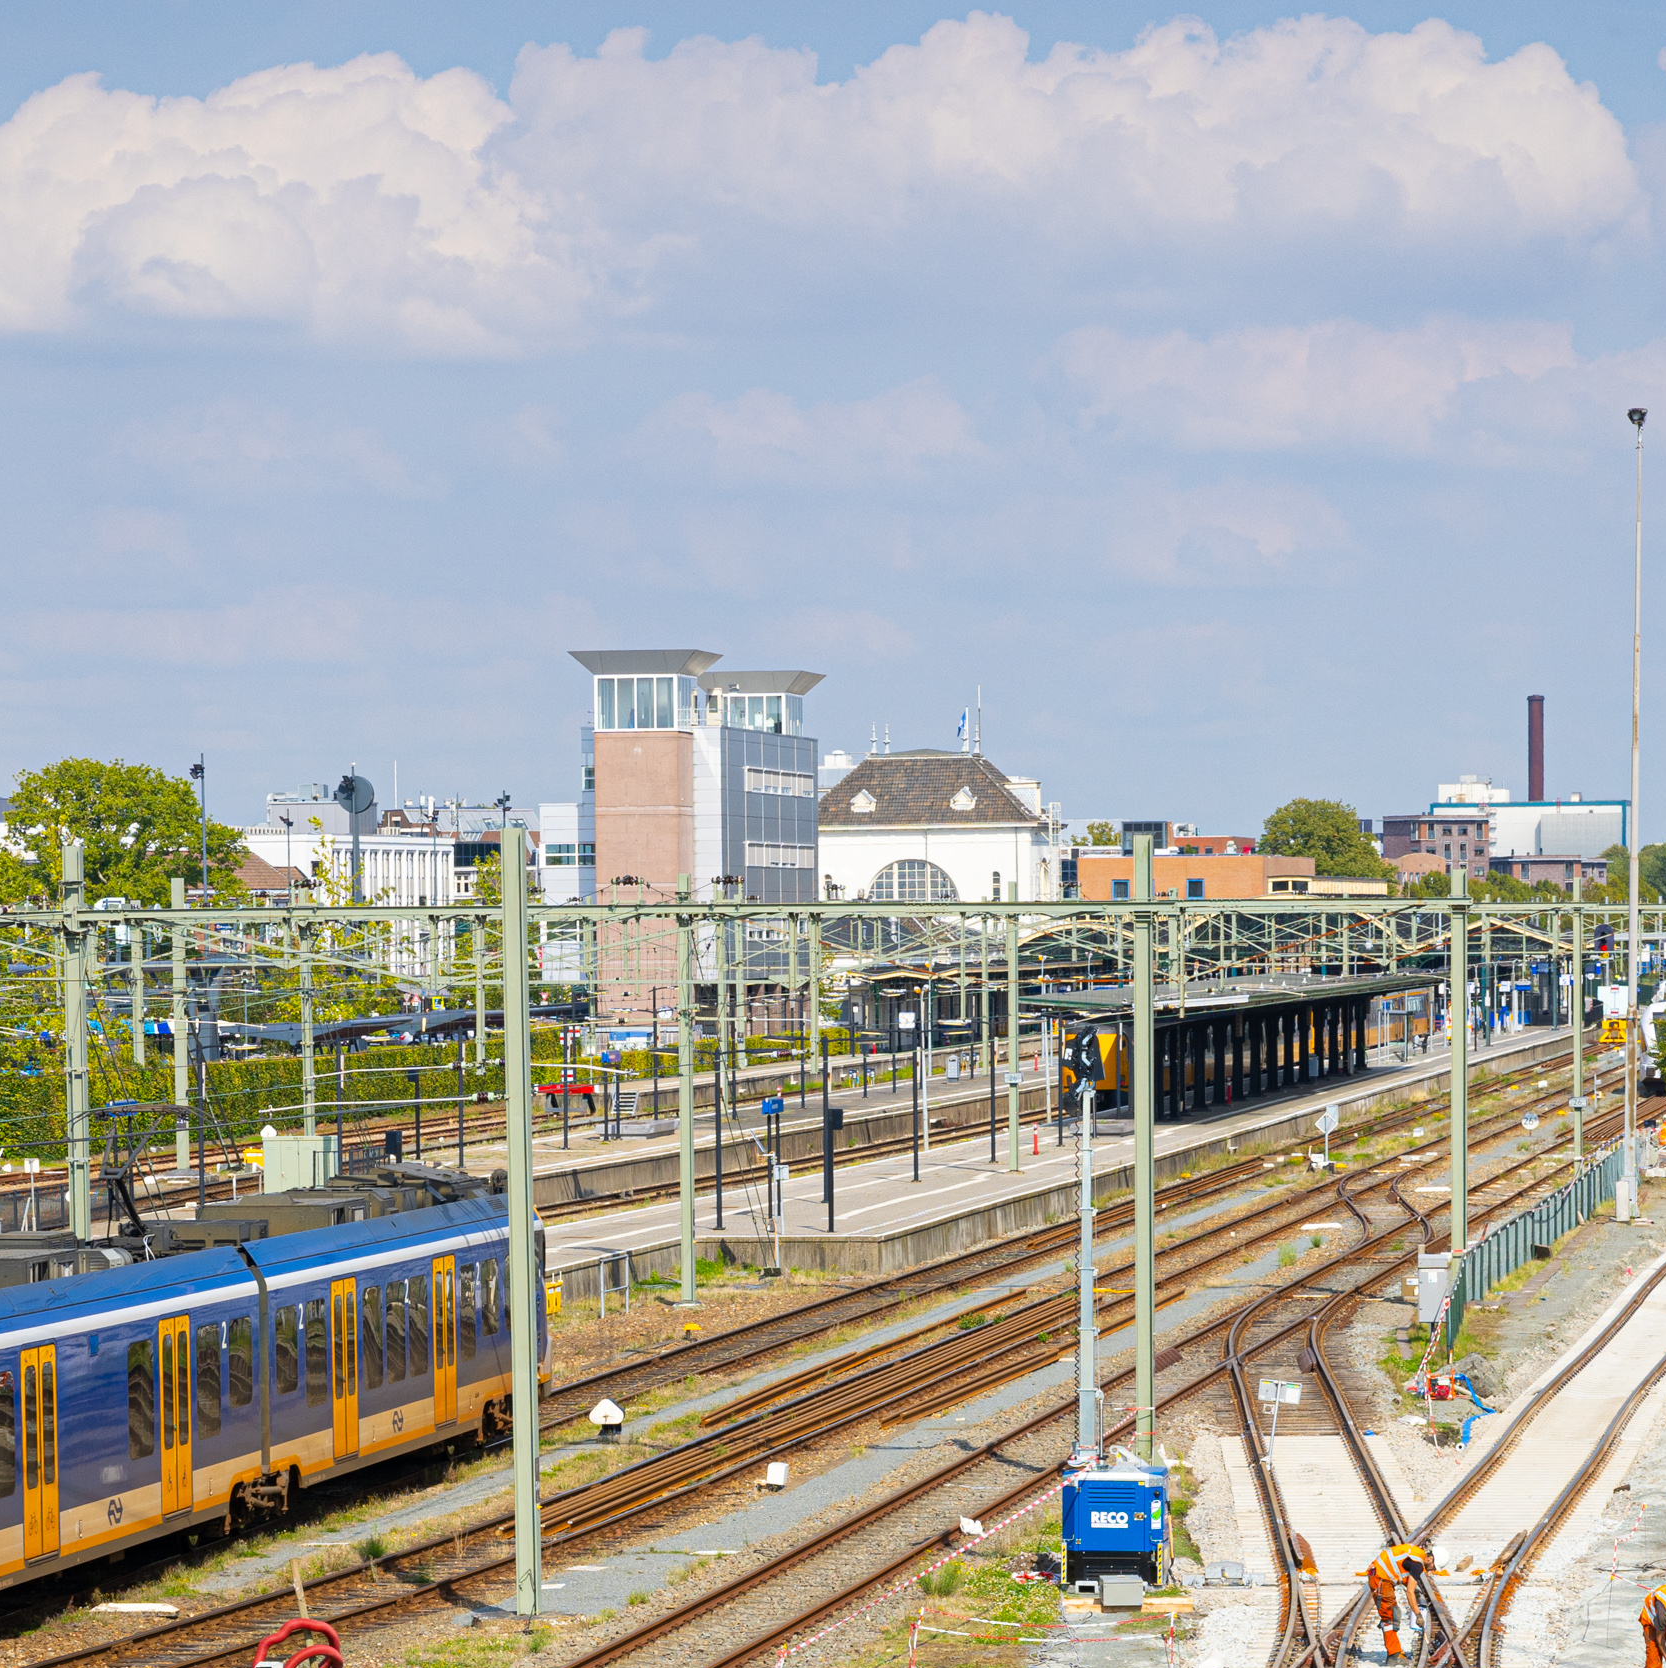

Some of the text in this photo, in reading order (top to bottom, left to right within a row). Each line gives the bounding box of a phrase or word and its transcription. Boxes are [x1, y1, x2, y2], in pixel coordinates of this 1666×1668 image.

[475, 1261, 480, 1286] 2
[404, 1278, 409, 1304] 2
[298, 1303, 304, 1330] 2
[221, 1321, 227, 1349] 2
[1090, 1511, 1129, 1524] RECO
